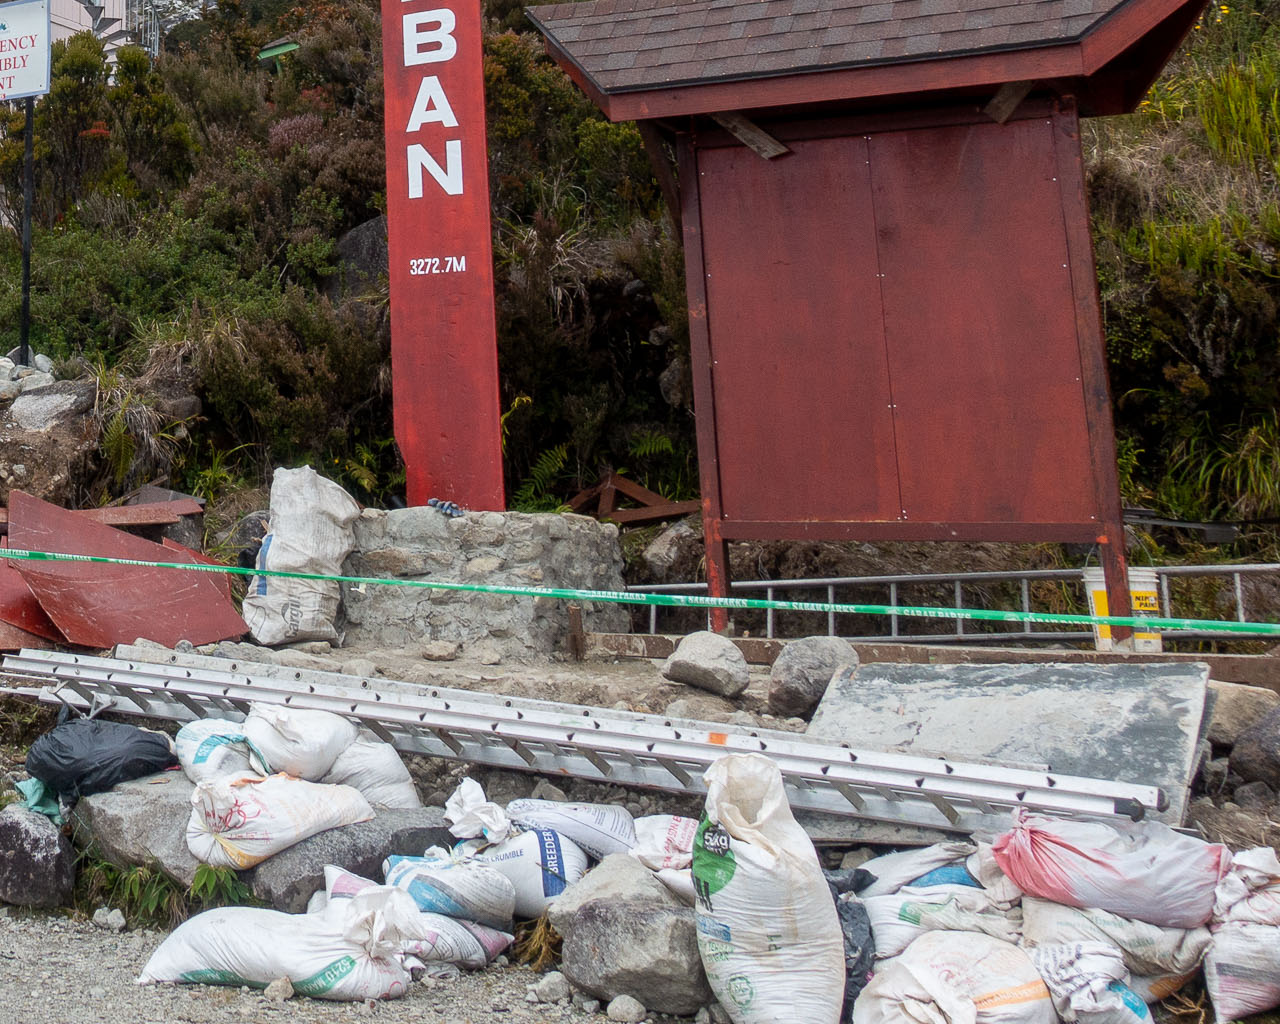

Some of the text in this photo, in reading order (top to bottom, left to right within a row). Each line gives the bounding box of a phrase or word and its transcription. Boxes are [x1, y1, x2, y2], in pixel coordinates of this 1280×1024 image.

[410, 256, 466, 275] 3272.7M
[688, 596, 748, 607] SABAH PARKS
[792, 602, 856, 613] SABAH PARKS
[491, 849, 524, 862] CRUMBLE
[542, 830, 560, 874] BREEDER
